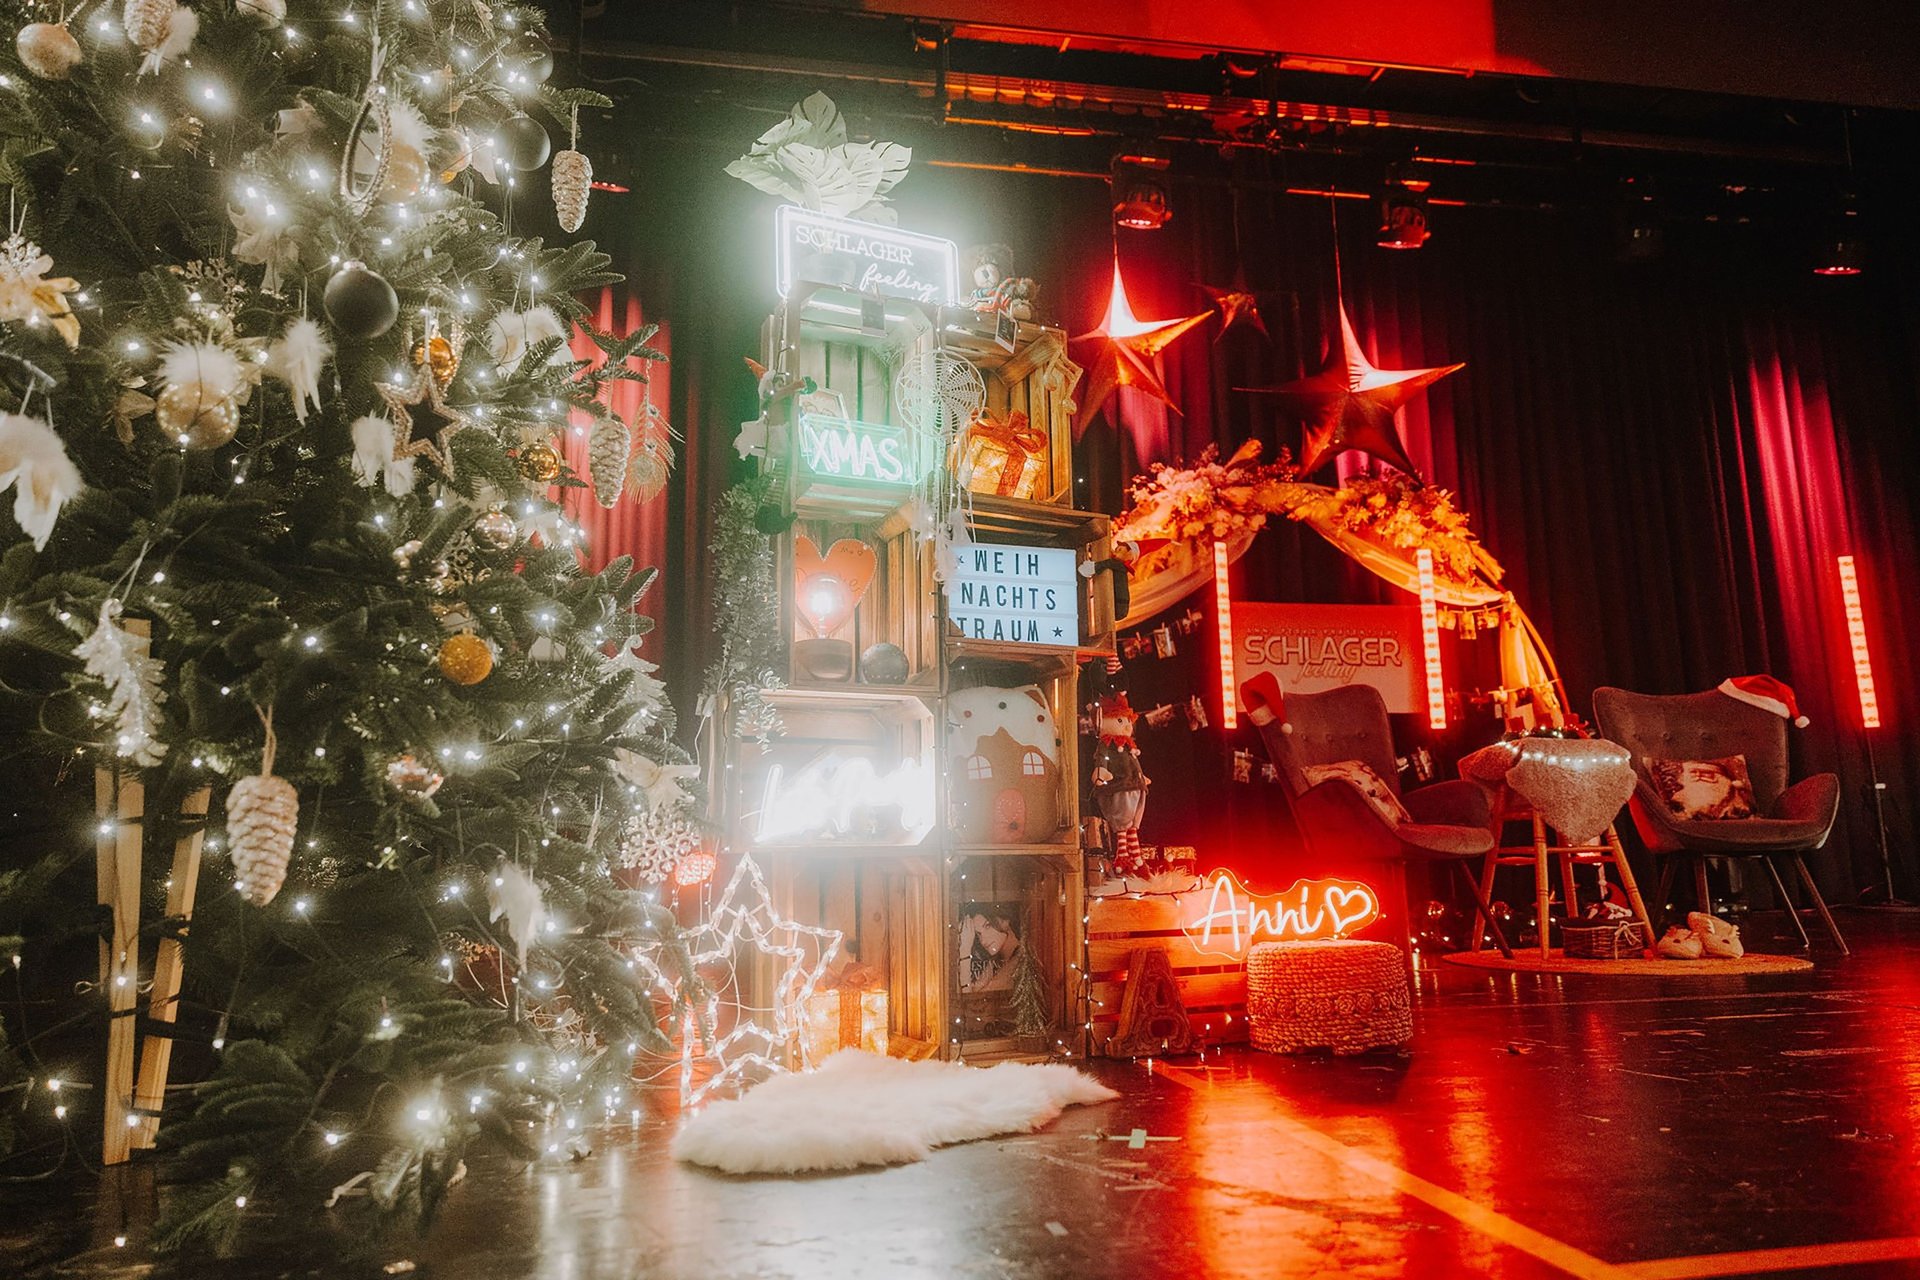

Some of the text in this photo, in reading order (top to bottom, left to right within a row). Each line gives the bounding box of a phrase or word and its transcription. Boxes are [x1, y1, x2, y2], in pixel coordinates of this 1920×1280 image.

[795, 224, 914, 267] SCHLAGER
[859, 262, 939, 303] feeling
[806, 425, 903, 481] XMAS
[974, 549, 1039, 576] WEIH
[961, 582, 1056, 610] NACHTS
[956, 616, 1039, 642] TRAUM
[1244, 635, 1402, 667] SCHLAGER
[1291, 659, 1357, 684] feeling
[1191, 875, 1324, 952] Anni
